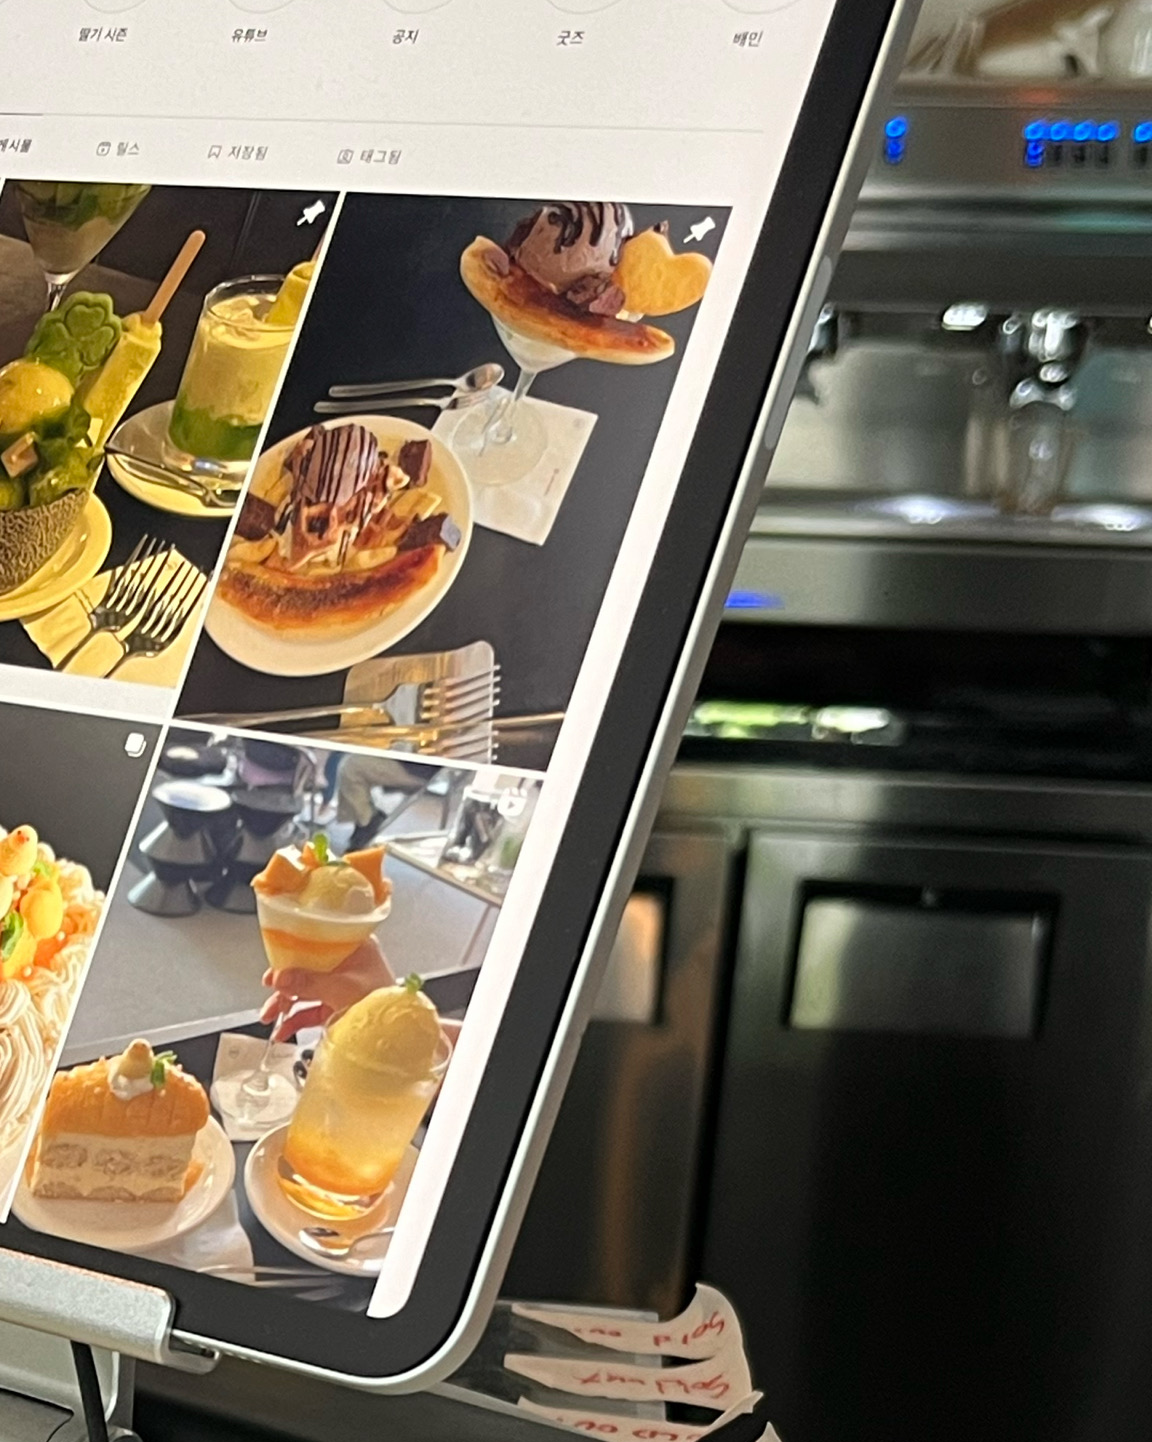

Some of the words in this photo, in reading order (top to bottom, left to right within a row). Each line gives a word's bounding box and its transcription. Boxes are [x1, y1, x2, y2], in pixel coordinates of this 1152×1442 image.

[78, 27, 101, 42] 딸기
[103, 27, 128, 42] 시즌
[231, 28, 268, 43] 유튜브
[392, 29, 420, 44] 공지
[556, 30, 585, 46] 굿즈
[732, 31, 764, 48] 배민
[115, 141, 141, 157] 릴스
[227, 145, 269, 161] 저장됨
[359, 149, 403, 165] 태그됨
